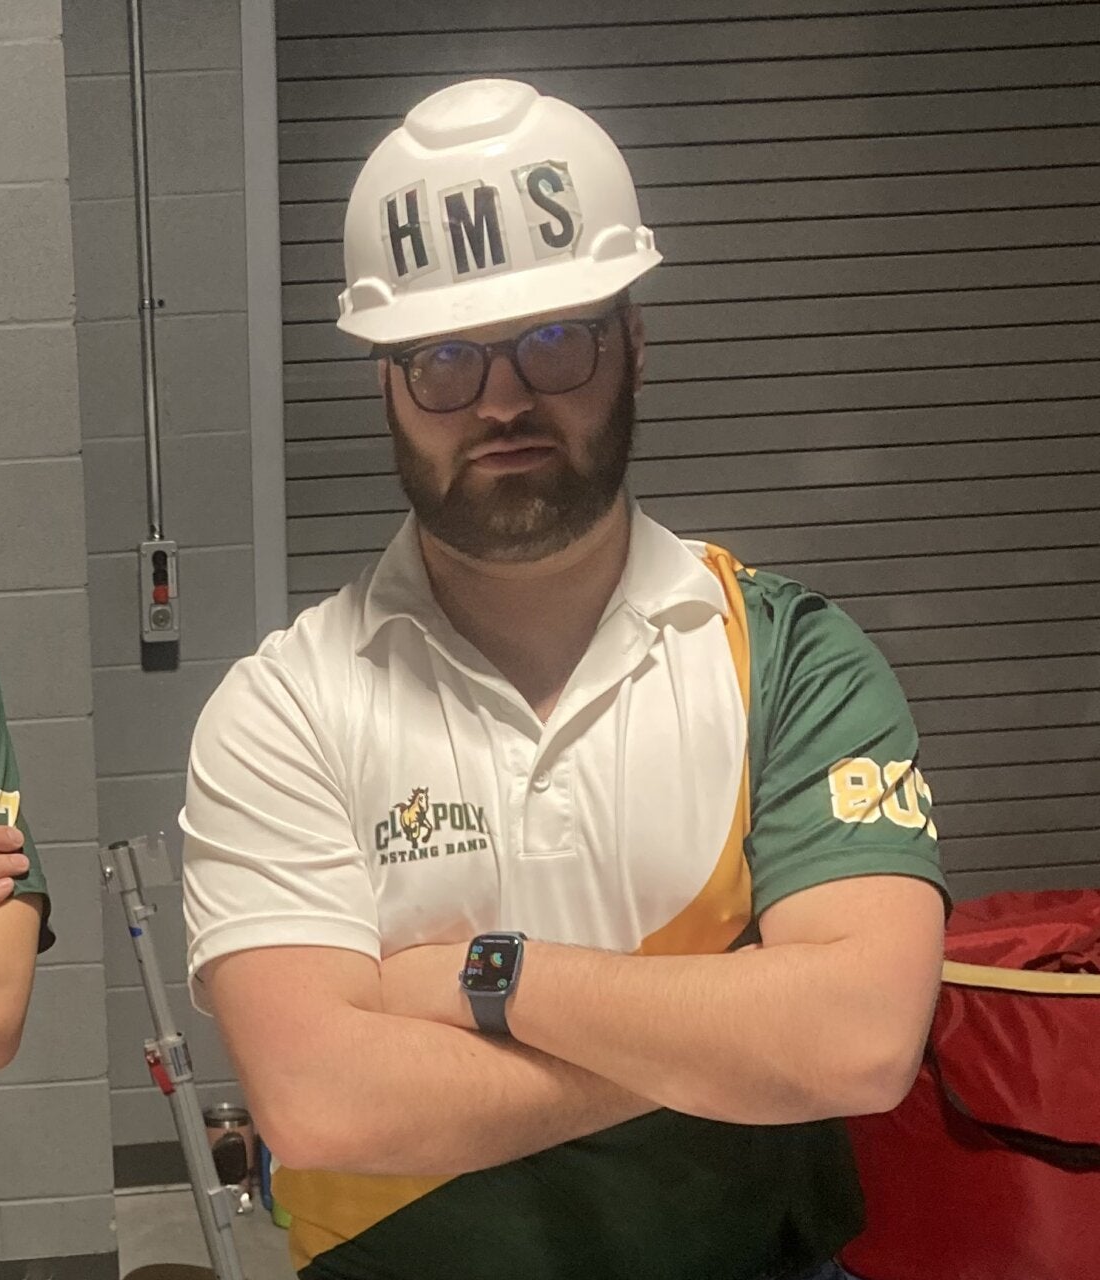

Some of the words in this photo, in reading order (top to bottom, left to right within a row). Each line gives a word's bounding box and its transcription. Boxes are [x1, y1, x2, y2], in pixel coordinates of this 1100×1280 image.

[386, 166, 574, 277] HMS
[431, 802, 485, 834] POLY
[445, 837, 488, 855] BAND
